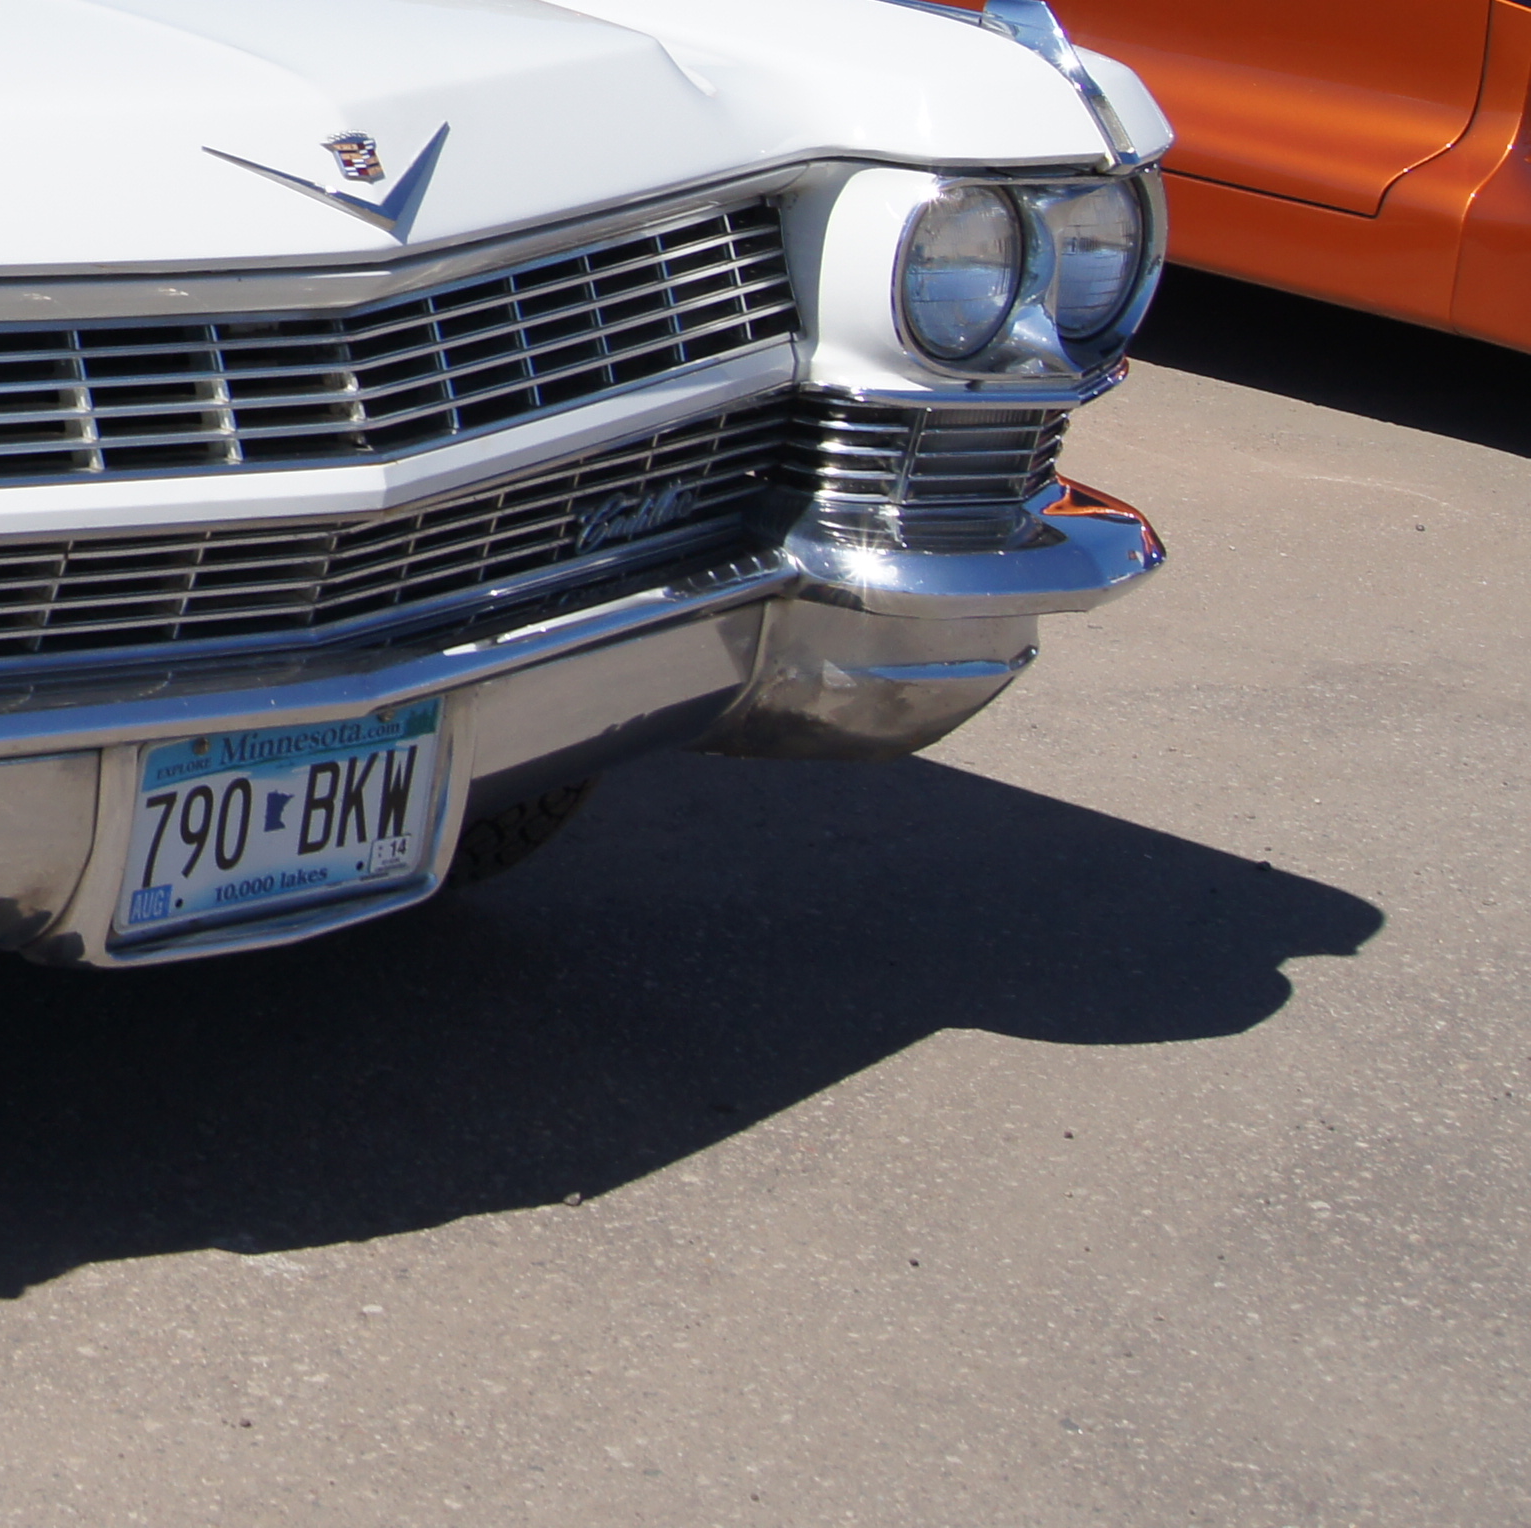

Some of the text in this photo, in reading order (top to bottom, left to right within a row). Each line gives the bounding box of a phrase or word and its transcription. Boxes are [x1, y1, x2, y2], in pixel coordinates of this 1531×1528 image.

[156, 723, 400, 780] EXPLORE Minnesota.com
[141, 745, 418, 888] 790 BKW
[390, 838, 407, 857] 14
[214, 867, 328, 902] 10,000 lakes
[133, 890, 166, 921] AUG
